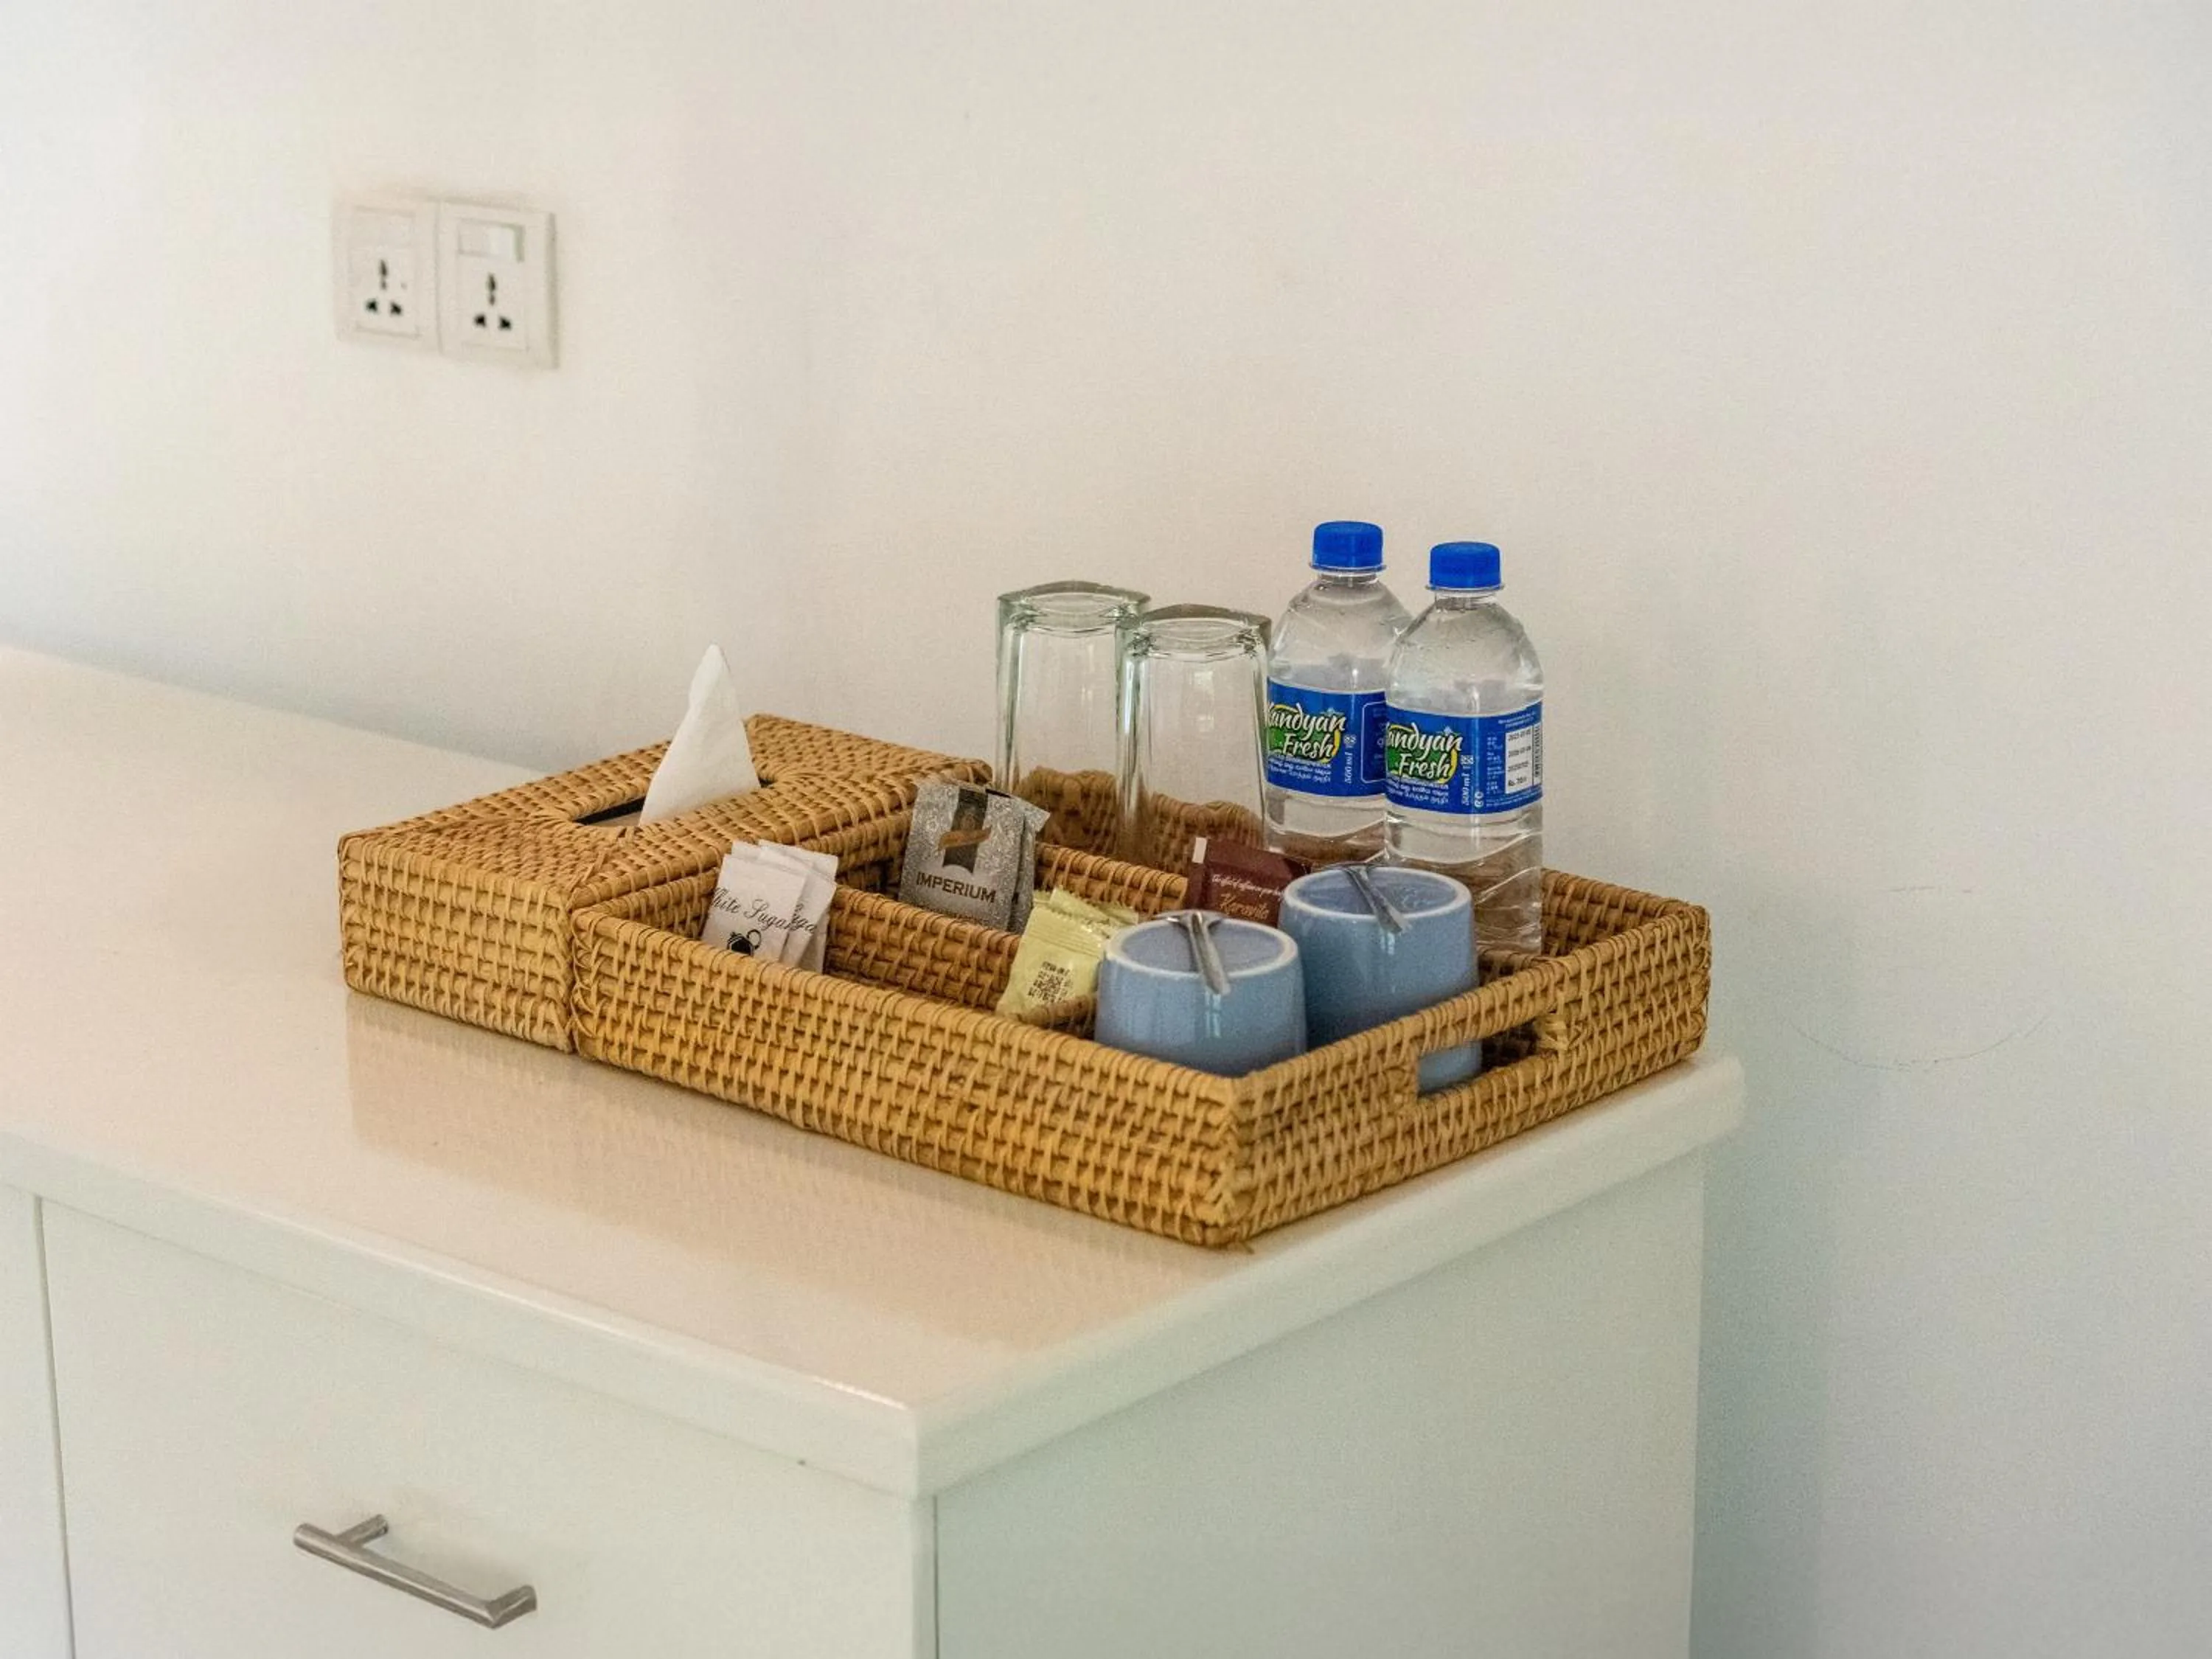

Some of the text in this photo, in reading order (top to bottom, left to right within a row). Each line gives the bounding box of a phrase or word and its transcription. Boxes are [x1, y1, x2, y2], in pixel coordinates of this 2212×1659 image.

[1282, 733, 1334, 759] Fresh
[1386, 722, 1464, 761] andyan
[1399, 752, 1451, 779] Fresh
[917, 872, 996, 903] IMPERIUM
